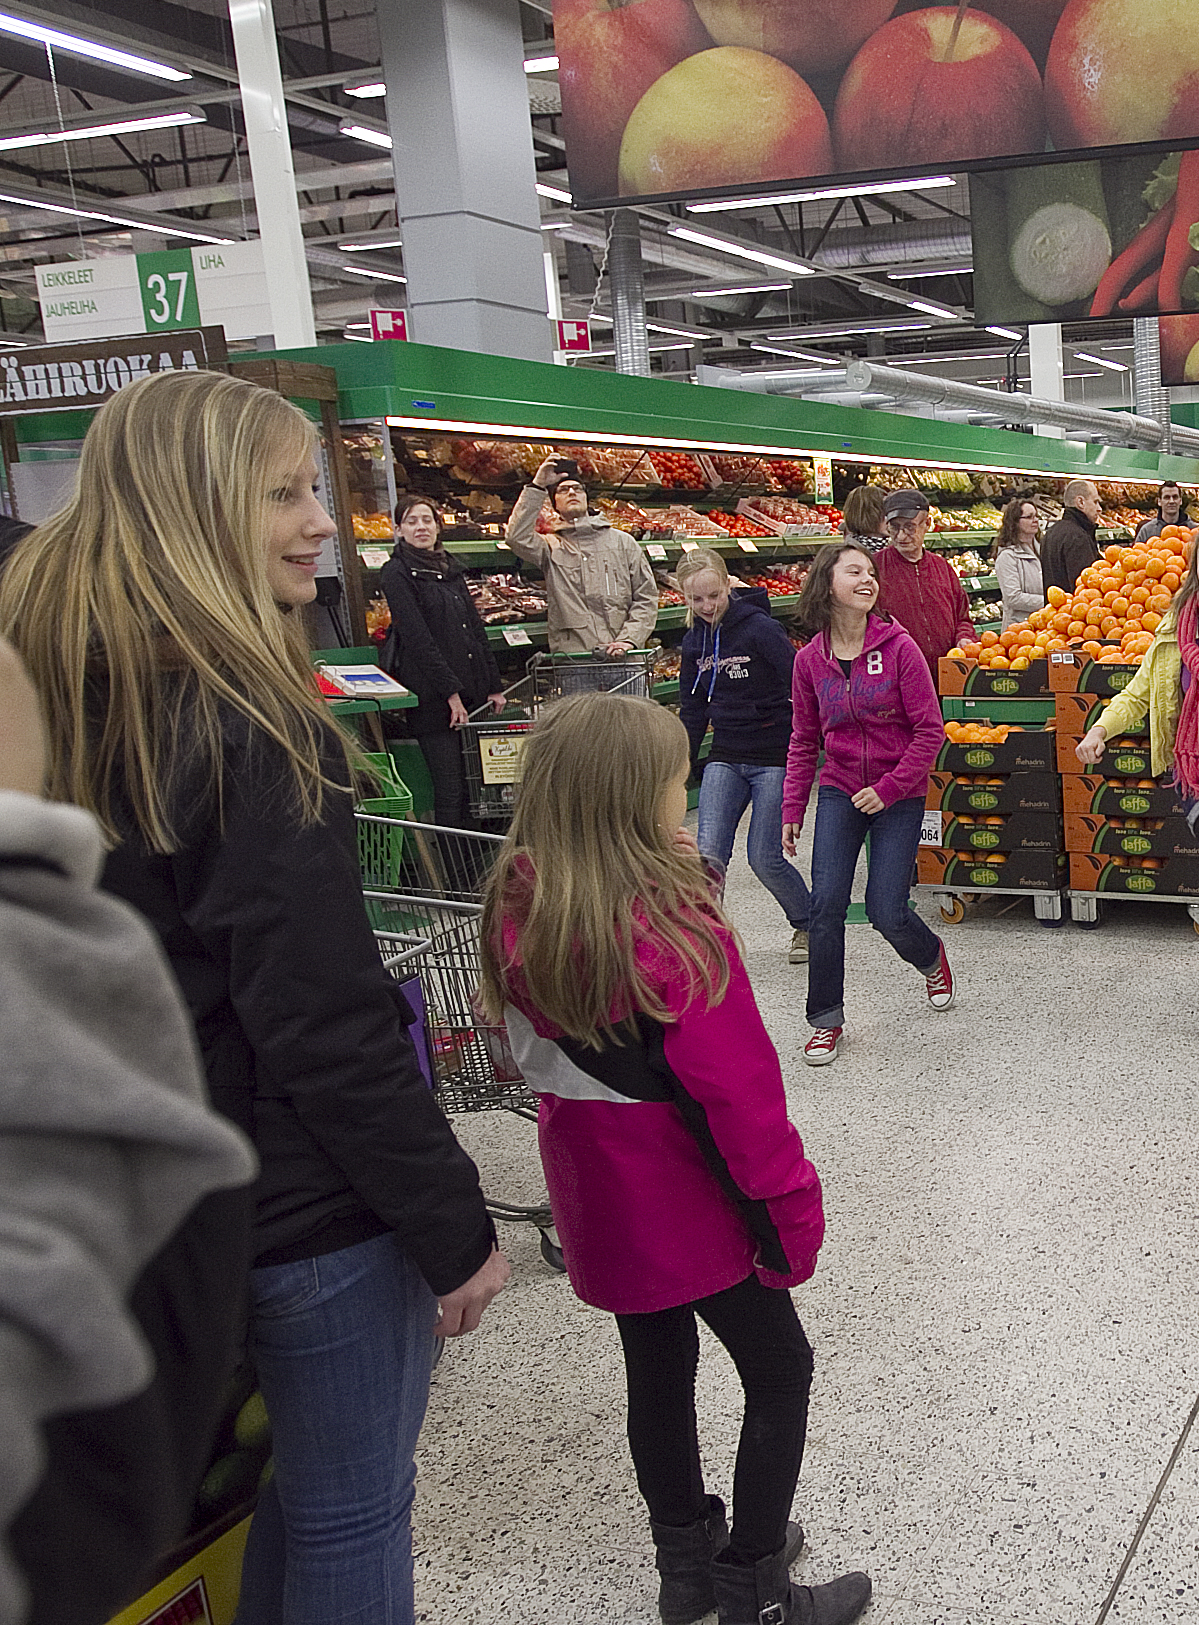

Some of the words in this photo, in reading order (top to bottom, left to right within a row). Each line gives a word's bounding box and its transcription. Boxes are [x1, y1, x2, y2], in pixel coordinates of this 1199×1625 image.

[199, 254, 225, 270] LIHA
[41, 268, 94, 288] LEIKKELEET
[147, 271, 189, 324] 37
[45, 299, 98, 319] JAUHELIHA
[0, 349, 199, 402] ÄHIRUOKAA
[867, 650, 883, 675] 8
[921, 828, 938, 842] 064
